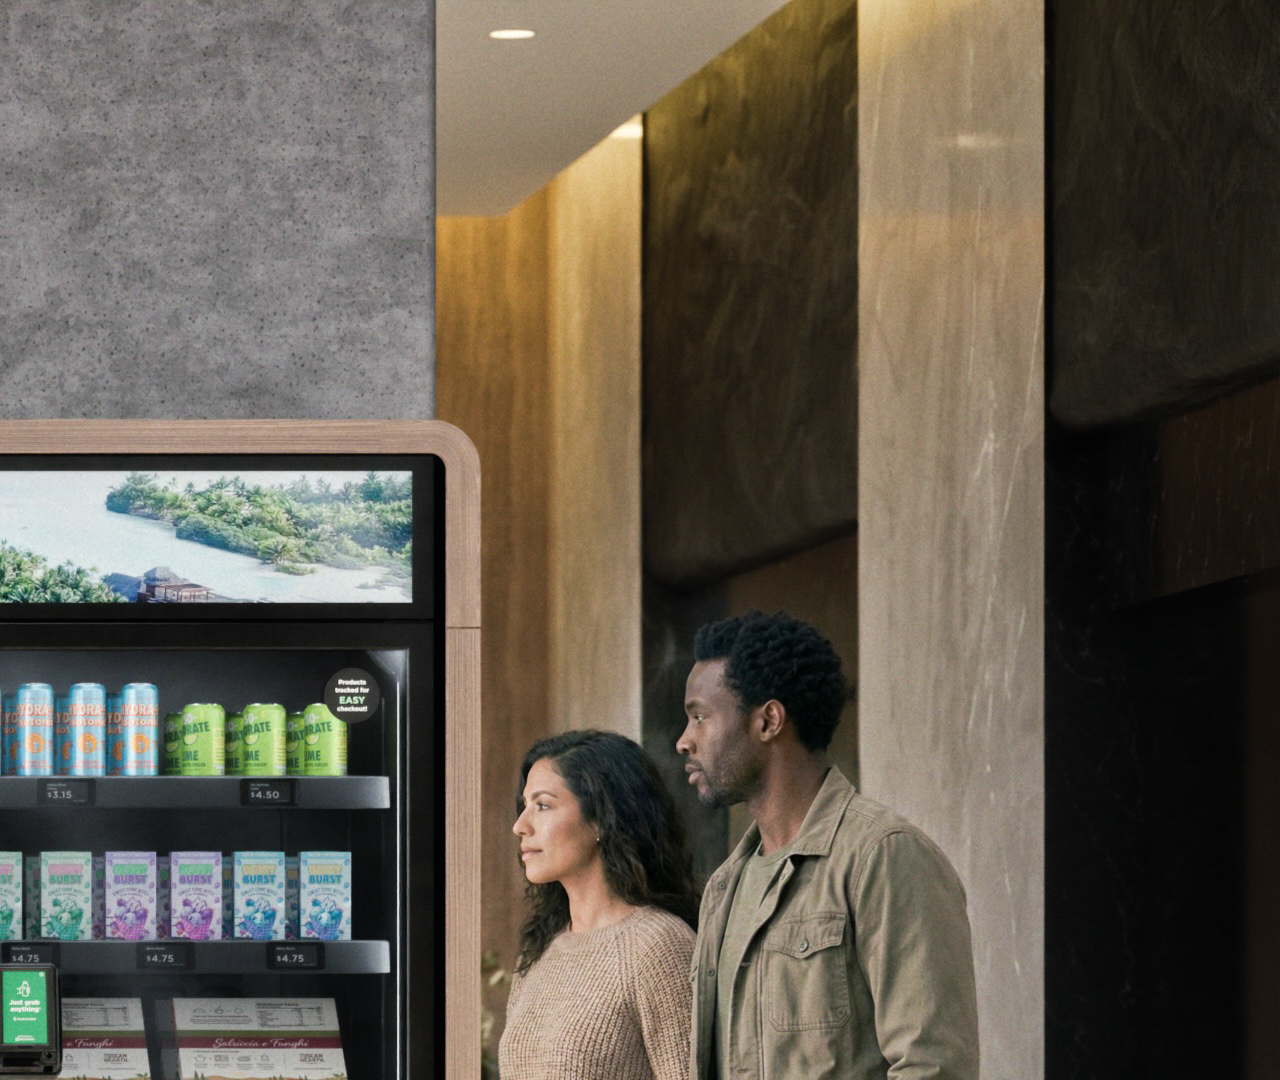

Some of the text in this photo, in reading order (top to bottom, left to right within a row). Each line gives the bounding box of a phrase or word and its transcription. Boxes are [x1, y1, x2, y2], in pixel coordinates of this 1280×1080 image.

[339, 696, 365, 704] EASY
[47, 791, 72, 799] $3.15
[250, 791, 280, 799] $4.50
[49, 875, 82, 884] BURST
[114, 875, 147, 884] BURST
[179, 875, 213, 884] BURST
[243, 875, 276, 884] BURST
[309, 875, 341, 884] BURST
[12, 955, 39, 963] $4.75
[146, 955, 174, 963] $4.75
[277, 955, 304, 963] $4.75
[24, 999, 40, 1007] grab
[212, 1038, 259, 1048] Salsiccia
[269, 1038, 310, 1049] Funghi
